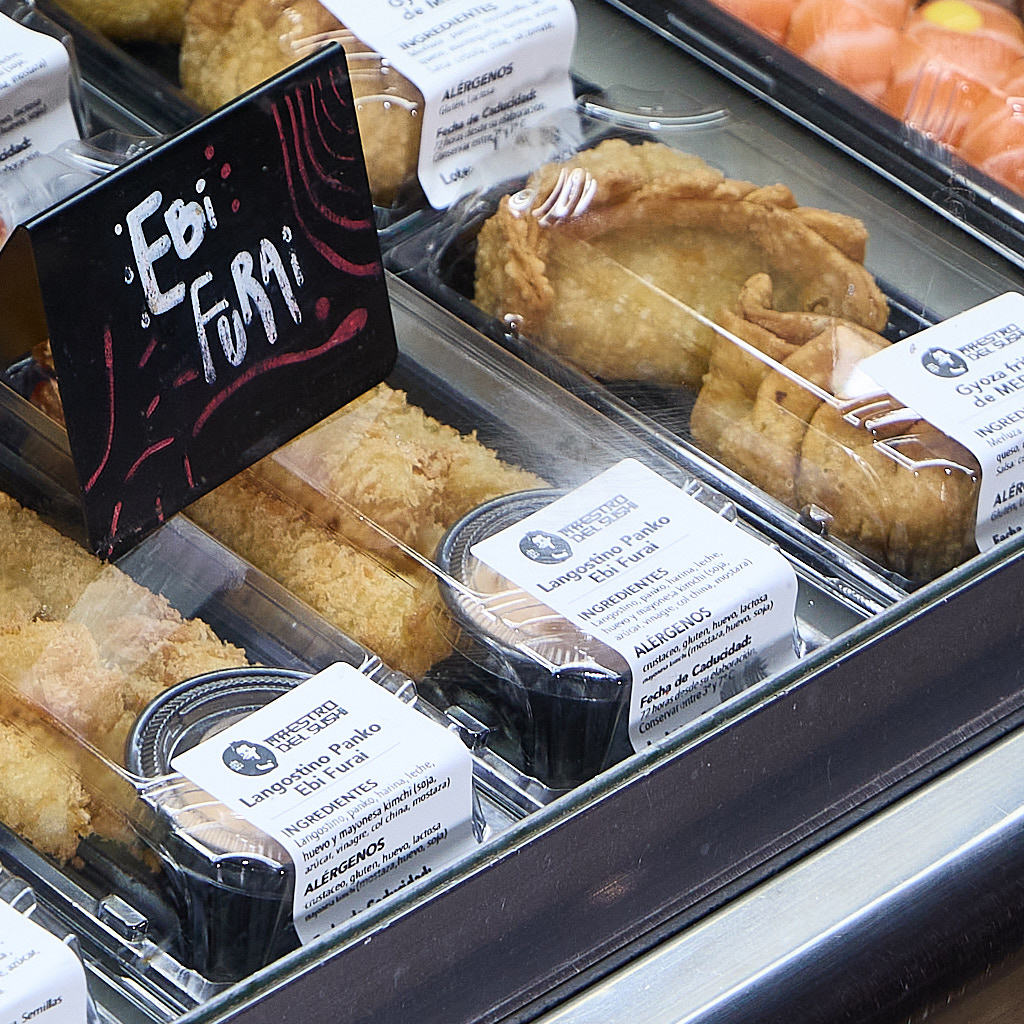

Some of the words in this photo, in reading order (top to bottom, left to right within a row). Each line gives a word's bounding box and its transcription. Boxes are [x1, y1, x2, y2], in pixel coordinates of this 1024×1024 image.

[398, 2, 498, 50] INGREDIENTES
[403, 7, 424, 20] de
[441, 62, 514, 102] ALÉRGENOS
[436, 120, 465, 138] Fecha
[467, 112, 479, 125] de
[967, 345, 996, 361] DEL
[956, 369, 1008, 397] Gyoza
[974, 393, 996, 409] de
[537, 544, 623, 593] Langostino
[619, 516, 671, 547] Panko
[569, 524, 603, 544] DEL
[588, 563, 620, 584] Ebi
[616, 540, 660, 569] Furai
[576, 567, 670, 622] INGREDIENTES
[753, 600, 774, 619] soja)
[633, 606, 712, 659] ALÉRGENOS
[642, 644, 681, 674] crustaceo,
[682, 628, 711, 650] gluten,
[712, 611, 739, 632] huevo,
[740, 593, 768, 615] lactosa
[640, 682, 673, 709] Fecha
[674, 673, 689, 688] de
[691, 634, 752, 677] Caducidad:
[239, 755, 331, 808] Langostino
[328, 723, 382, 756] Panko
[275, 733, 310, 753] DEL
[294, 775, 327, 797] Ebi
[322, 749, 370, 780] Furai
[280, 778, 379, 838] INGREDIENTES
[302, 839, 331, 862] huevo
[330, 835, 338, 847] y
[339, 807, 383, 840] mayonesa
[383, 786, 413, 812] kimchi
[412, 775, 437, 795] (soja,
[371, 817, 383, 833] col
[385, 804, 411, 824] china,
[412, 777, 451, 807] mostaza)
[427, 828, 449, 849] soja)
[304, 836, 386, 897] ALÉRGENOS
[305, 880, 348, 910] crustaceo,
[349, 862, 381, 885] gluten,
[382, 841, 411, 864] huevo,
[413, 821, 441, 845] lactosa
